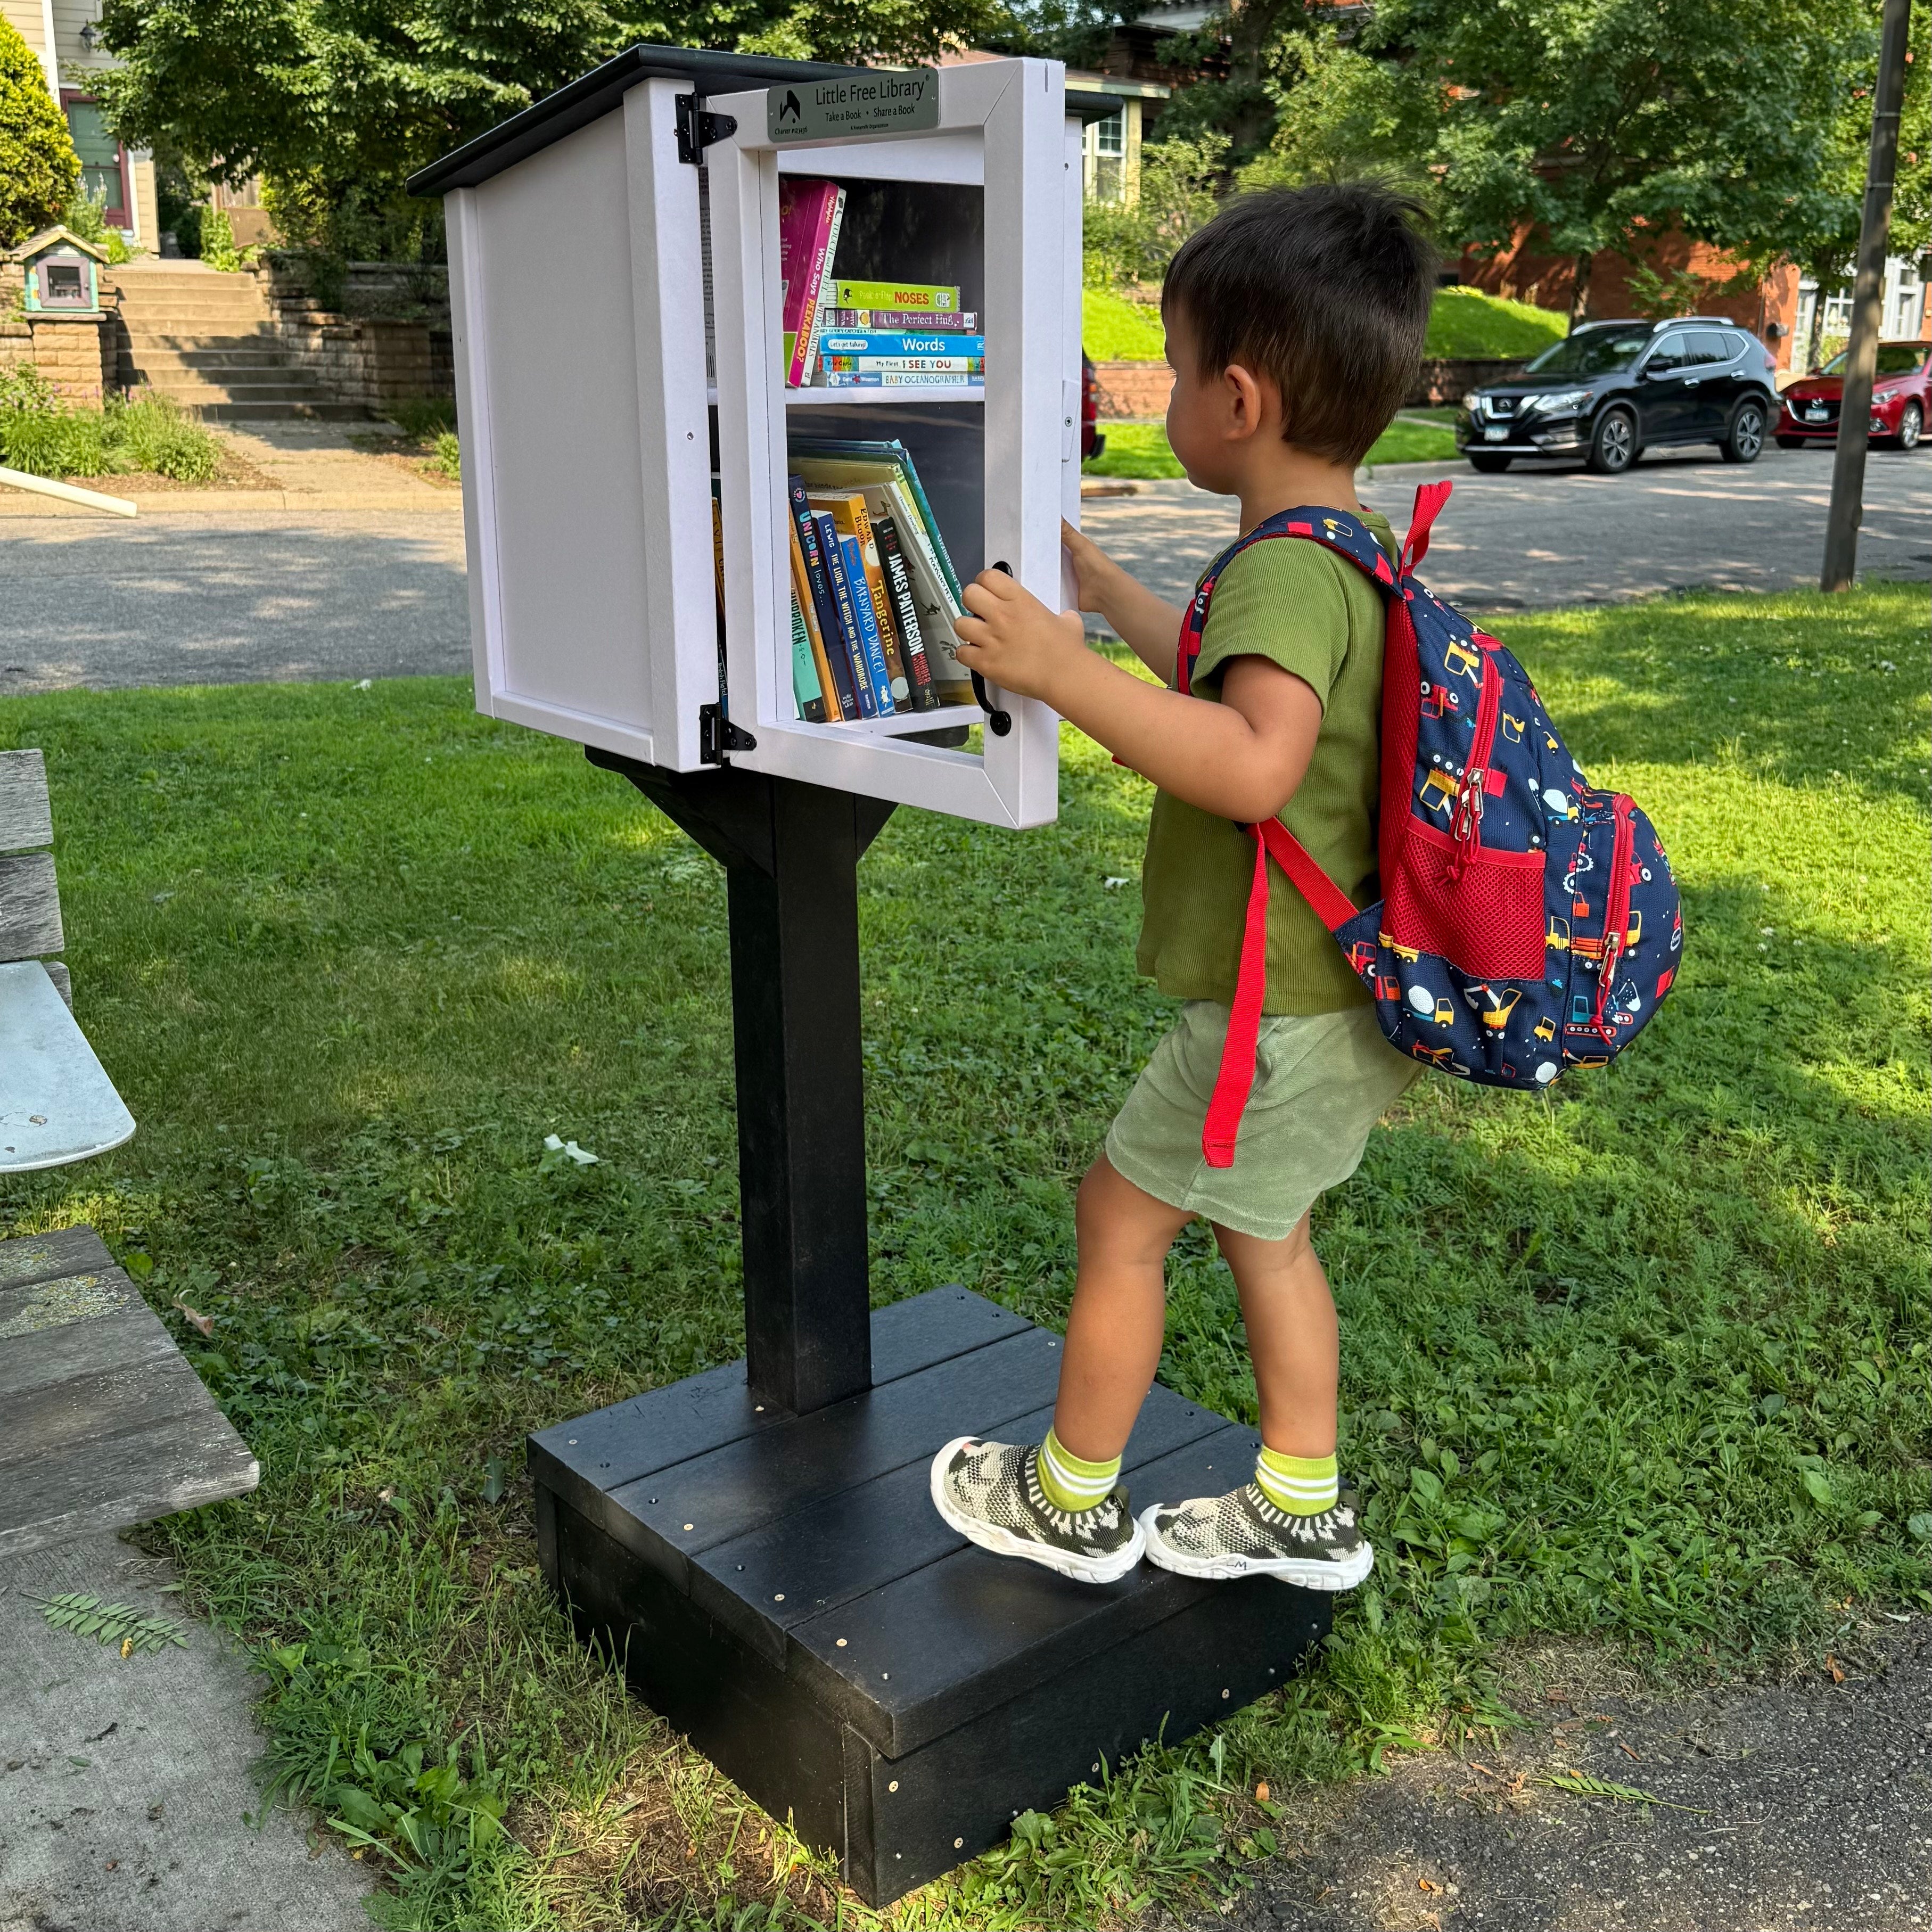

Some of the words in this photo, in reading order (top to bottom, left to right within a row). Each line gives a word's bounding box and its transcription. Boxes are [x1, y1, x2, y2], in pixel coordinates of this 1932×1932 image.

[816, 84, 846, 105] Little
[850, 85, 876, 102] Free
[825, 112, 840, 122] Take
[846, 108, 861, 120] Book
[873, 105, 892, 118] Share
[893, 108, 897, 116] a
[898, 102, 916, 116] Book
[815, 248, 826, 272] Who
[810, 272, 820, 296] Says
[894, 292, 930, 305] NOSES
[815, 302, 825, 322] WILD
[882, 312, 899, 324] The
[902, 313, 932, 324] Perfect
[935, 314, 954, 325] Hug
[796, 297, 816, 363] PEEKABOO?
[808, 323, 821, 358] ANIMALS
[902, 338, 946, 351] Words
[909, 360, 926, 369] SEE
[930, 360, 951, 369] YOU
[885, 375, 903, 384] BABY
[905, 374, 965, 384] OCEANOGRAPHER
[798, 510, 820, 567] UNICORN
[824, 523, 835, 548] LEWIS
[854, 516, 866, 546] BLOOR
[860, 507, 874, 549] EDWARD
[831, 553, 840, 566] THE
[887, 553, 909, 593] JAMES
[837, 586, 848, 601] THE
[841, 601, 853, 626] WITCH
[853, 576, 876, 632] BARNYARD
[867, 632, 886, 674] DANCE!
[870, 579, 895, 656] Tangerine
[897, 590, 925, 657] PATTERSON
[847, 626, 857, 639] AND
[852, 652, 869, 691] WARDROBE
